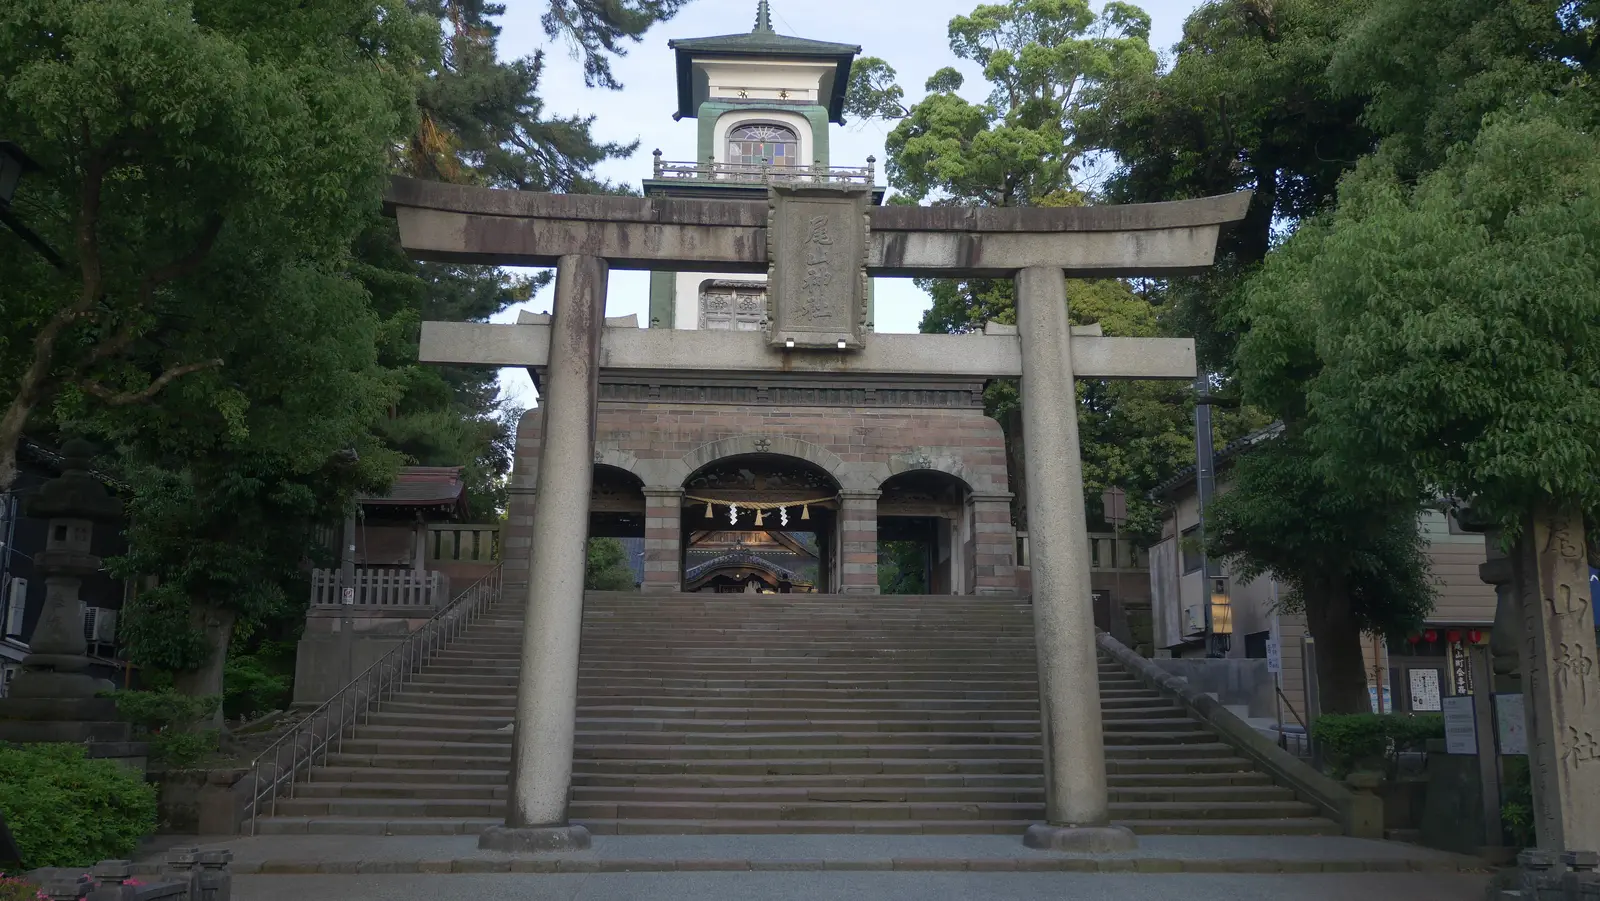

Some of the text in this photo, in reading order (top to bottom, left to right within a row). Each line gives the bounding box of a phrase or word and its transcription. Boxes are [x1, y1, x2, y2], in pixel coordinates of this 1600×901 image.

[801, 215, 834, 322] 尾山神社
[1542, 517, 1600, 771] 尾山神社
